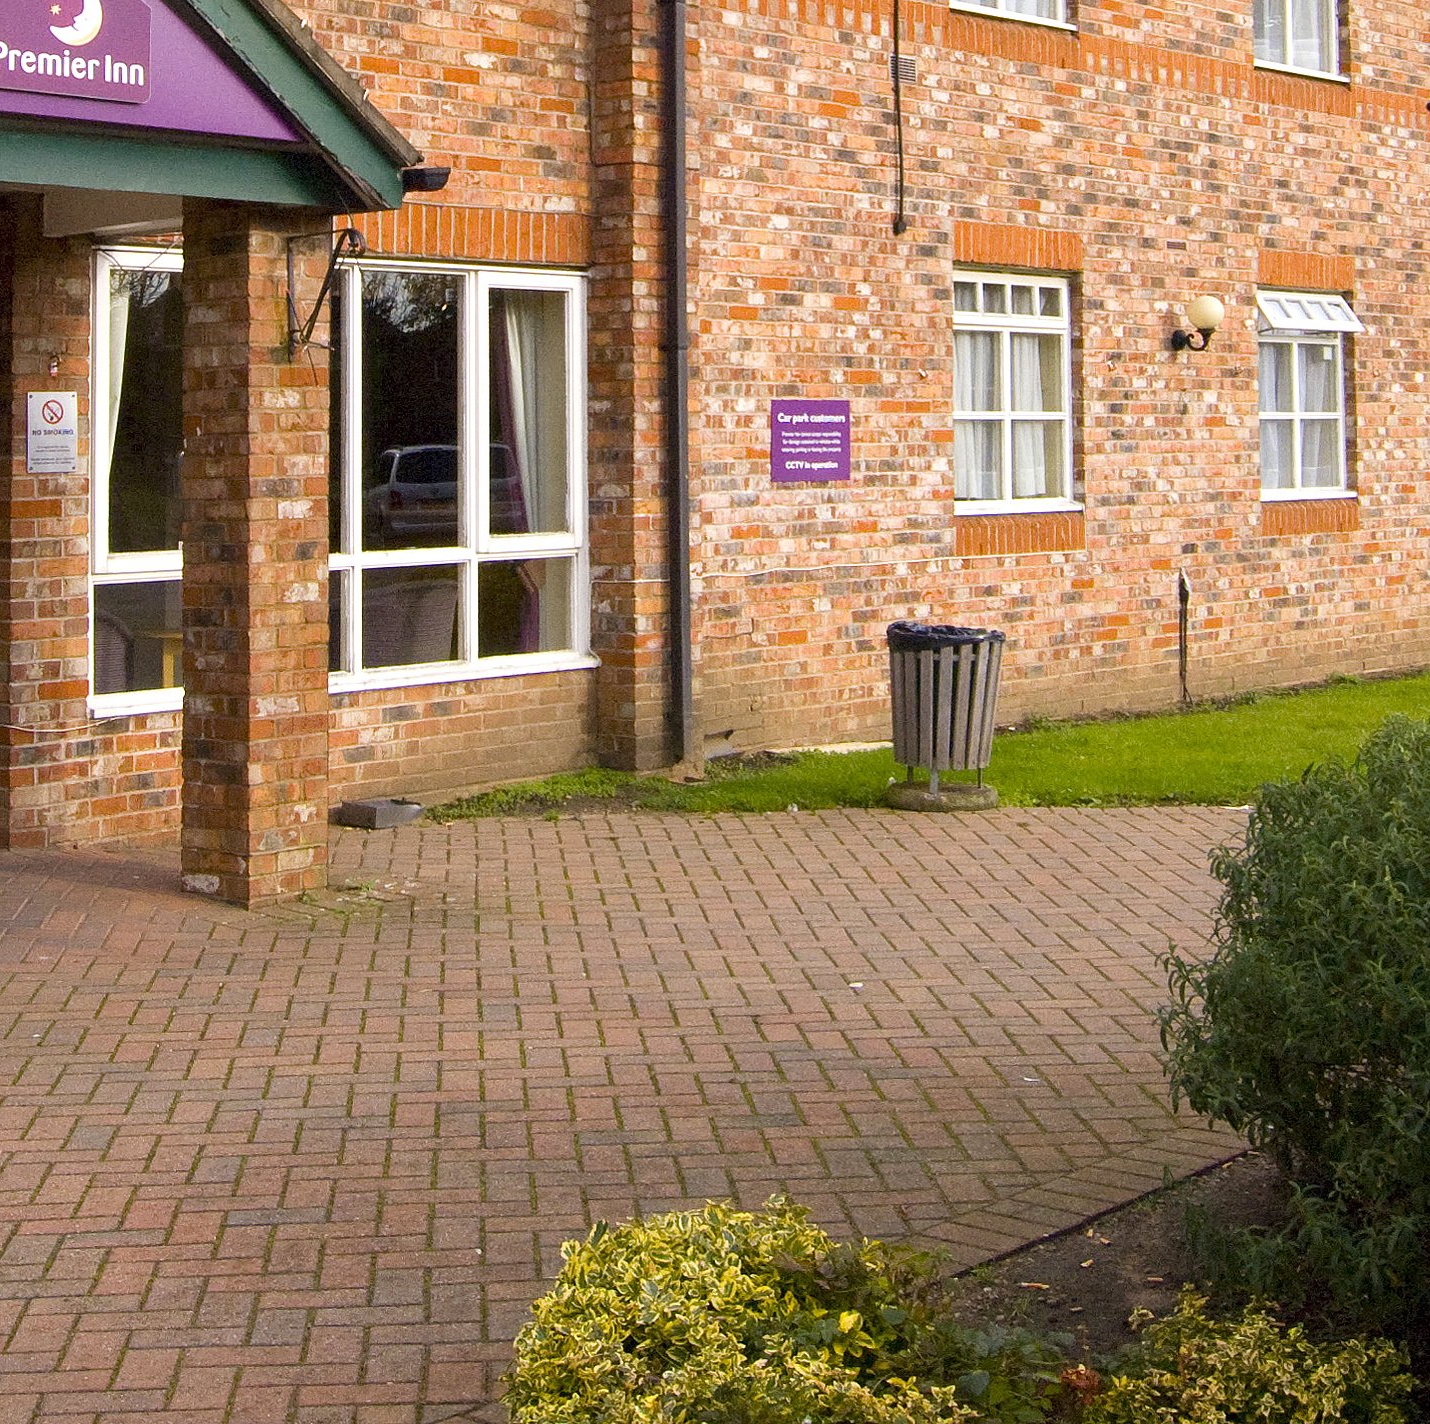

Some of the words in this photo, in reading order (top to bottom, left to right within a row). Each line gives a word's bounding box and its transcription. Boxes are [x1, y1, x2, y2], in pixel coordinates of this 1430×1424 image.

[104, 54, 145, 87] Inn
[777, 412, 792, 423] Car
[792, 413, 809, 425] park
[810, 414, 846, 423] customers
[785, 460, 804, 469] CCTV
[811, 461, 839, 470] operation
